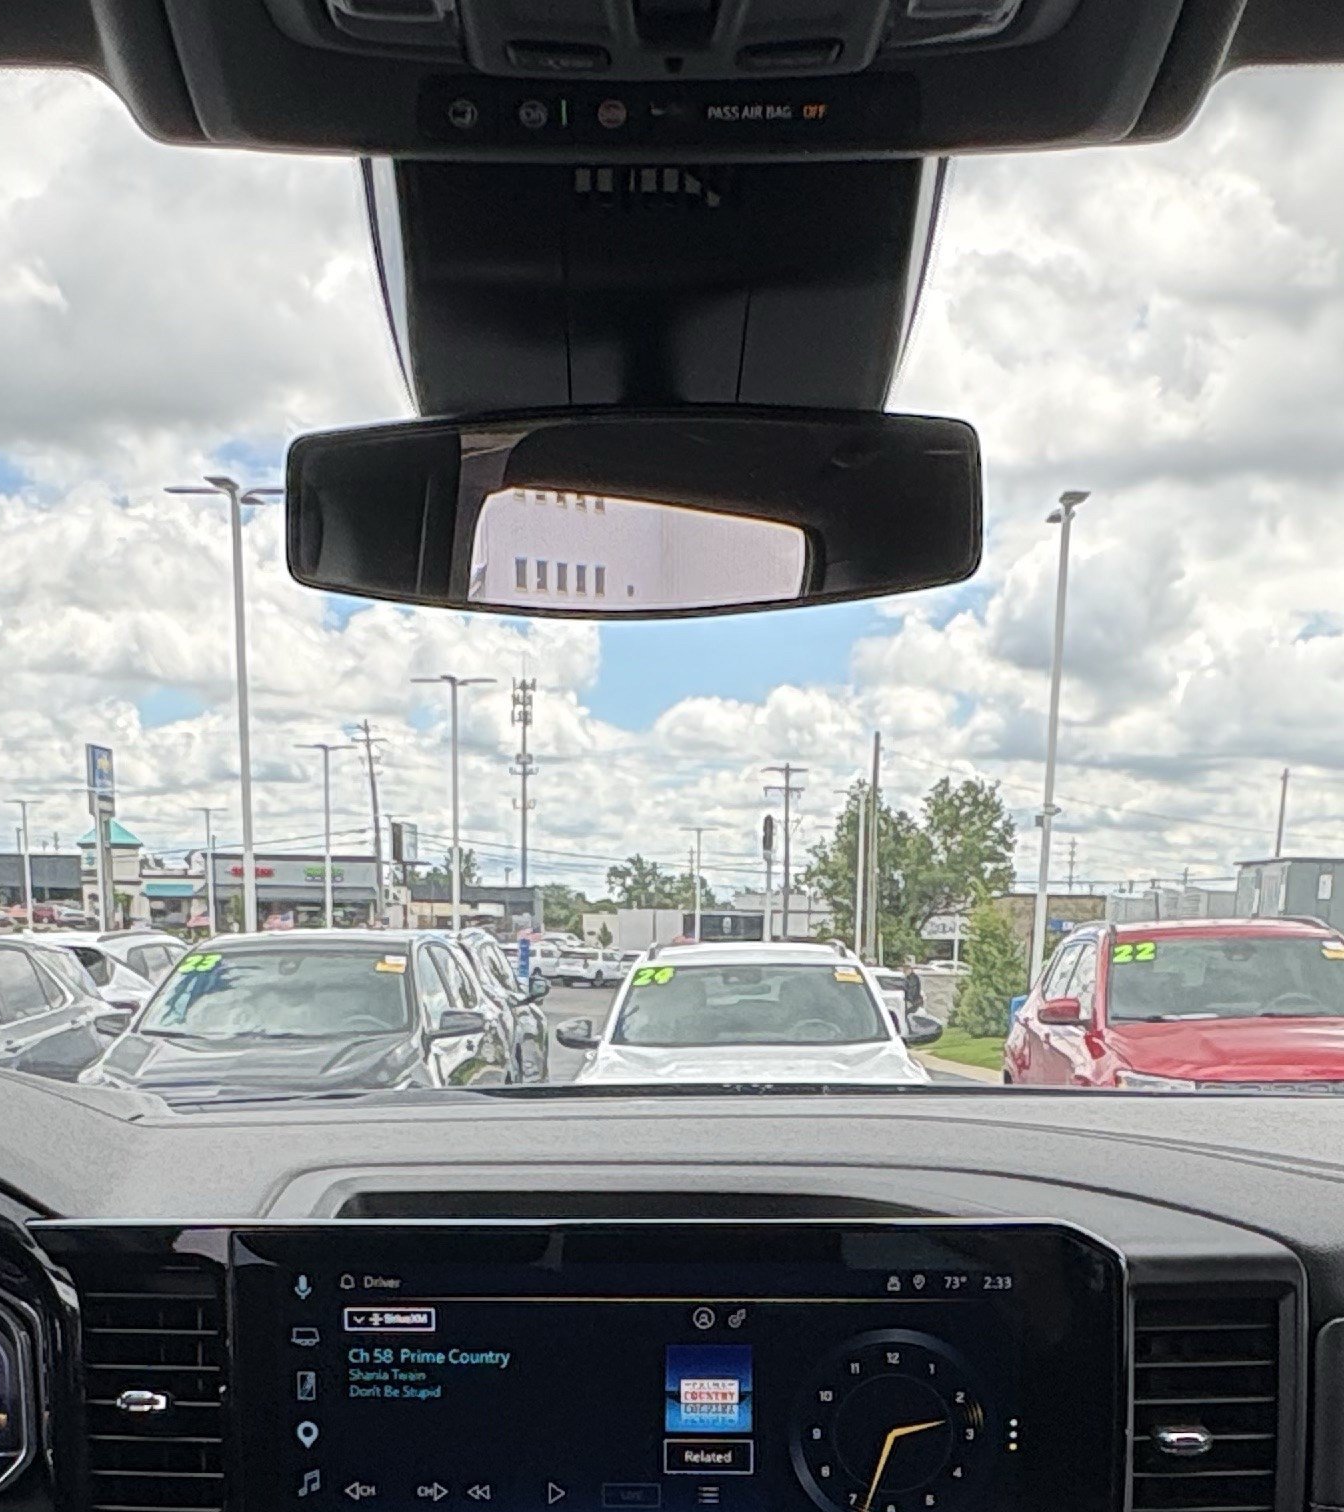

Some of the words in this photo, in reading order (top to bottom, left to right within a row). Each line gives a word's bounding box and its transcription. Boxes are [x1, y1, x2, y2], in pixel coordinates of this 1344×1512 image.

[707, 105, 739, 121] PASS
[741, 105, 763, 120] AIR
[766, 105, 792, 120] BAG
[803, 104, 826, 119] OFF
[1112, 942, 1156, 963] 22
[363, 1275, 402, 1289] Driver
[982, 1276, 1013, 1290] 2:33
[348, 1349, 370, 1363] Ch
[373, 1349, 394, 1364] 58
[400, 1349, 446, 1364] Prime
[448, 1349, 511, 1369] Country
[886, 1352, 900, 1365] 12
[349, 1368, 389, 1382] Shania
[384, 1385, 400, 1398] Be
[403, 1385, 442, 1400] Stupid
[684, 1450, 733, 1464] Related
